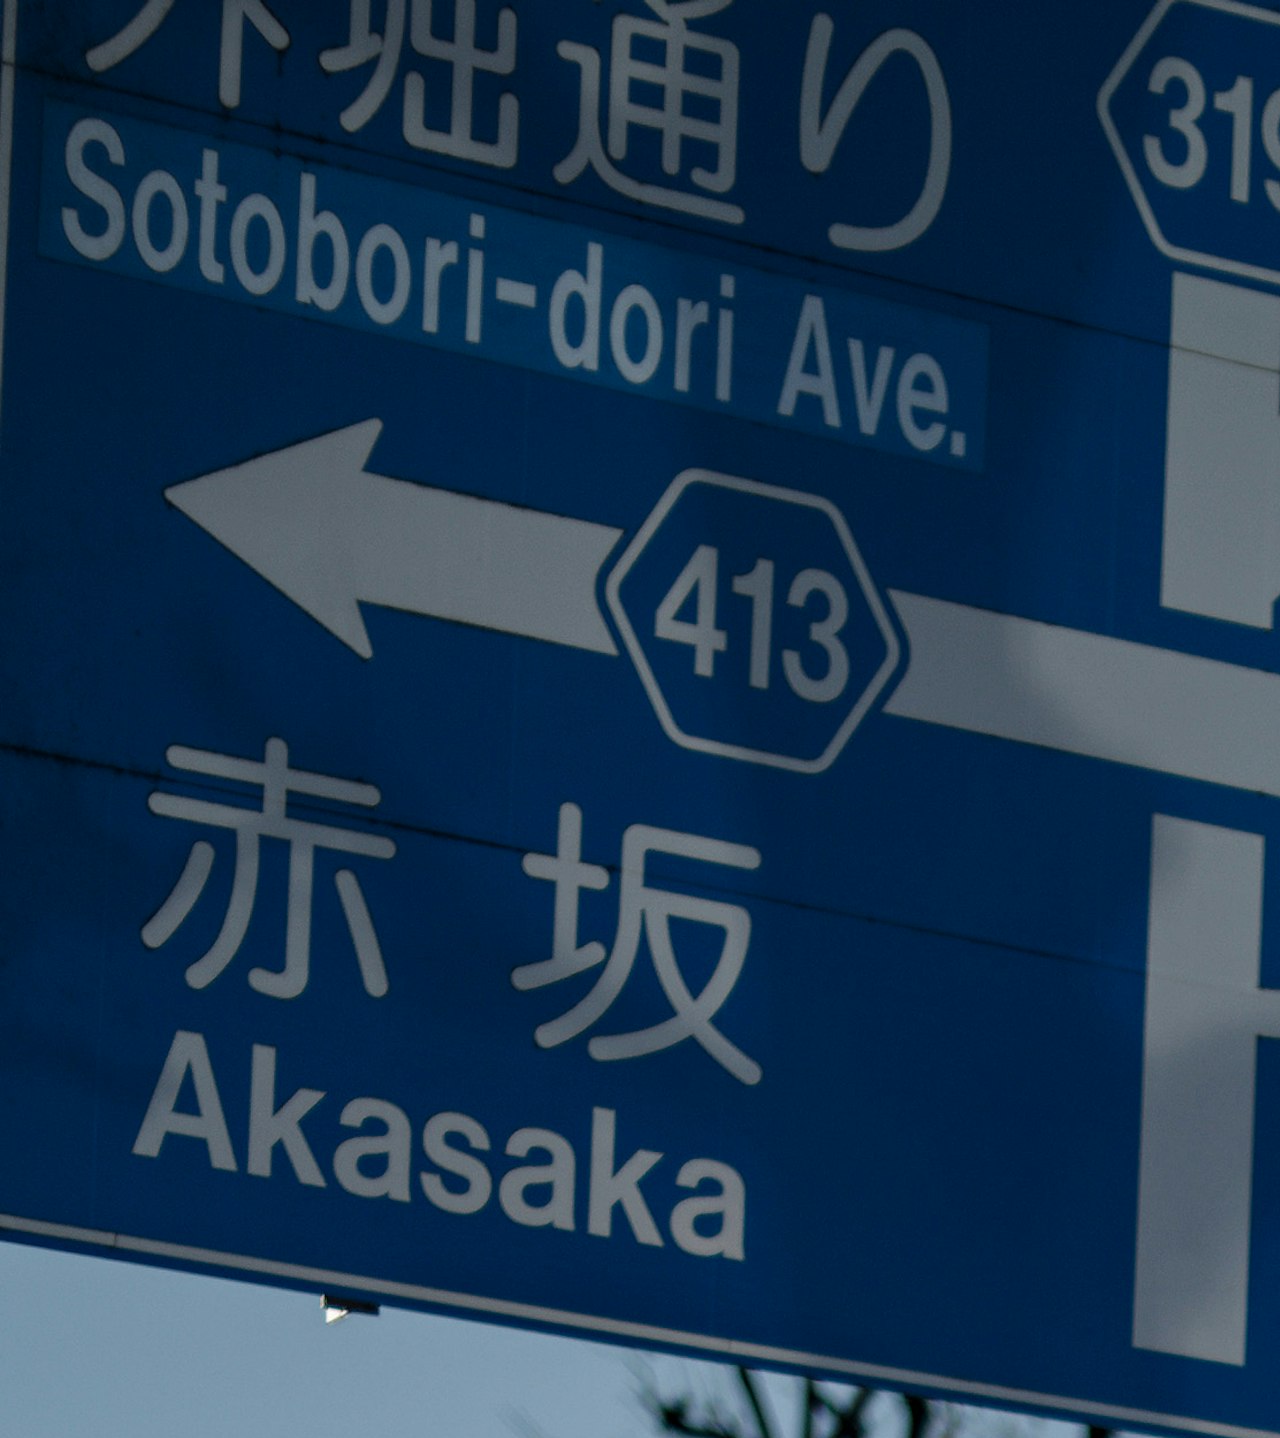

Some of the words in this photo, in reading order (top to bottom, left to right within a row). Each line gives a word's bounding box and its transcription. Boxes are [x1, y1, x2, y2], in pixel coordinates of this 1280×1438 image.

[62, 118, 736, 402] Sotobori-dori
[776, 295, 967, 458] Ave.
[653, 544, 850, 704] 413
[141, 736, 763, 1086] 赤坂
[132, 1029, 747, 1263] Akasaka
